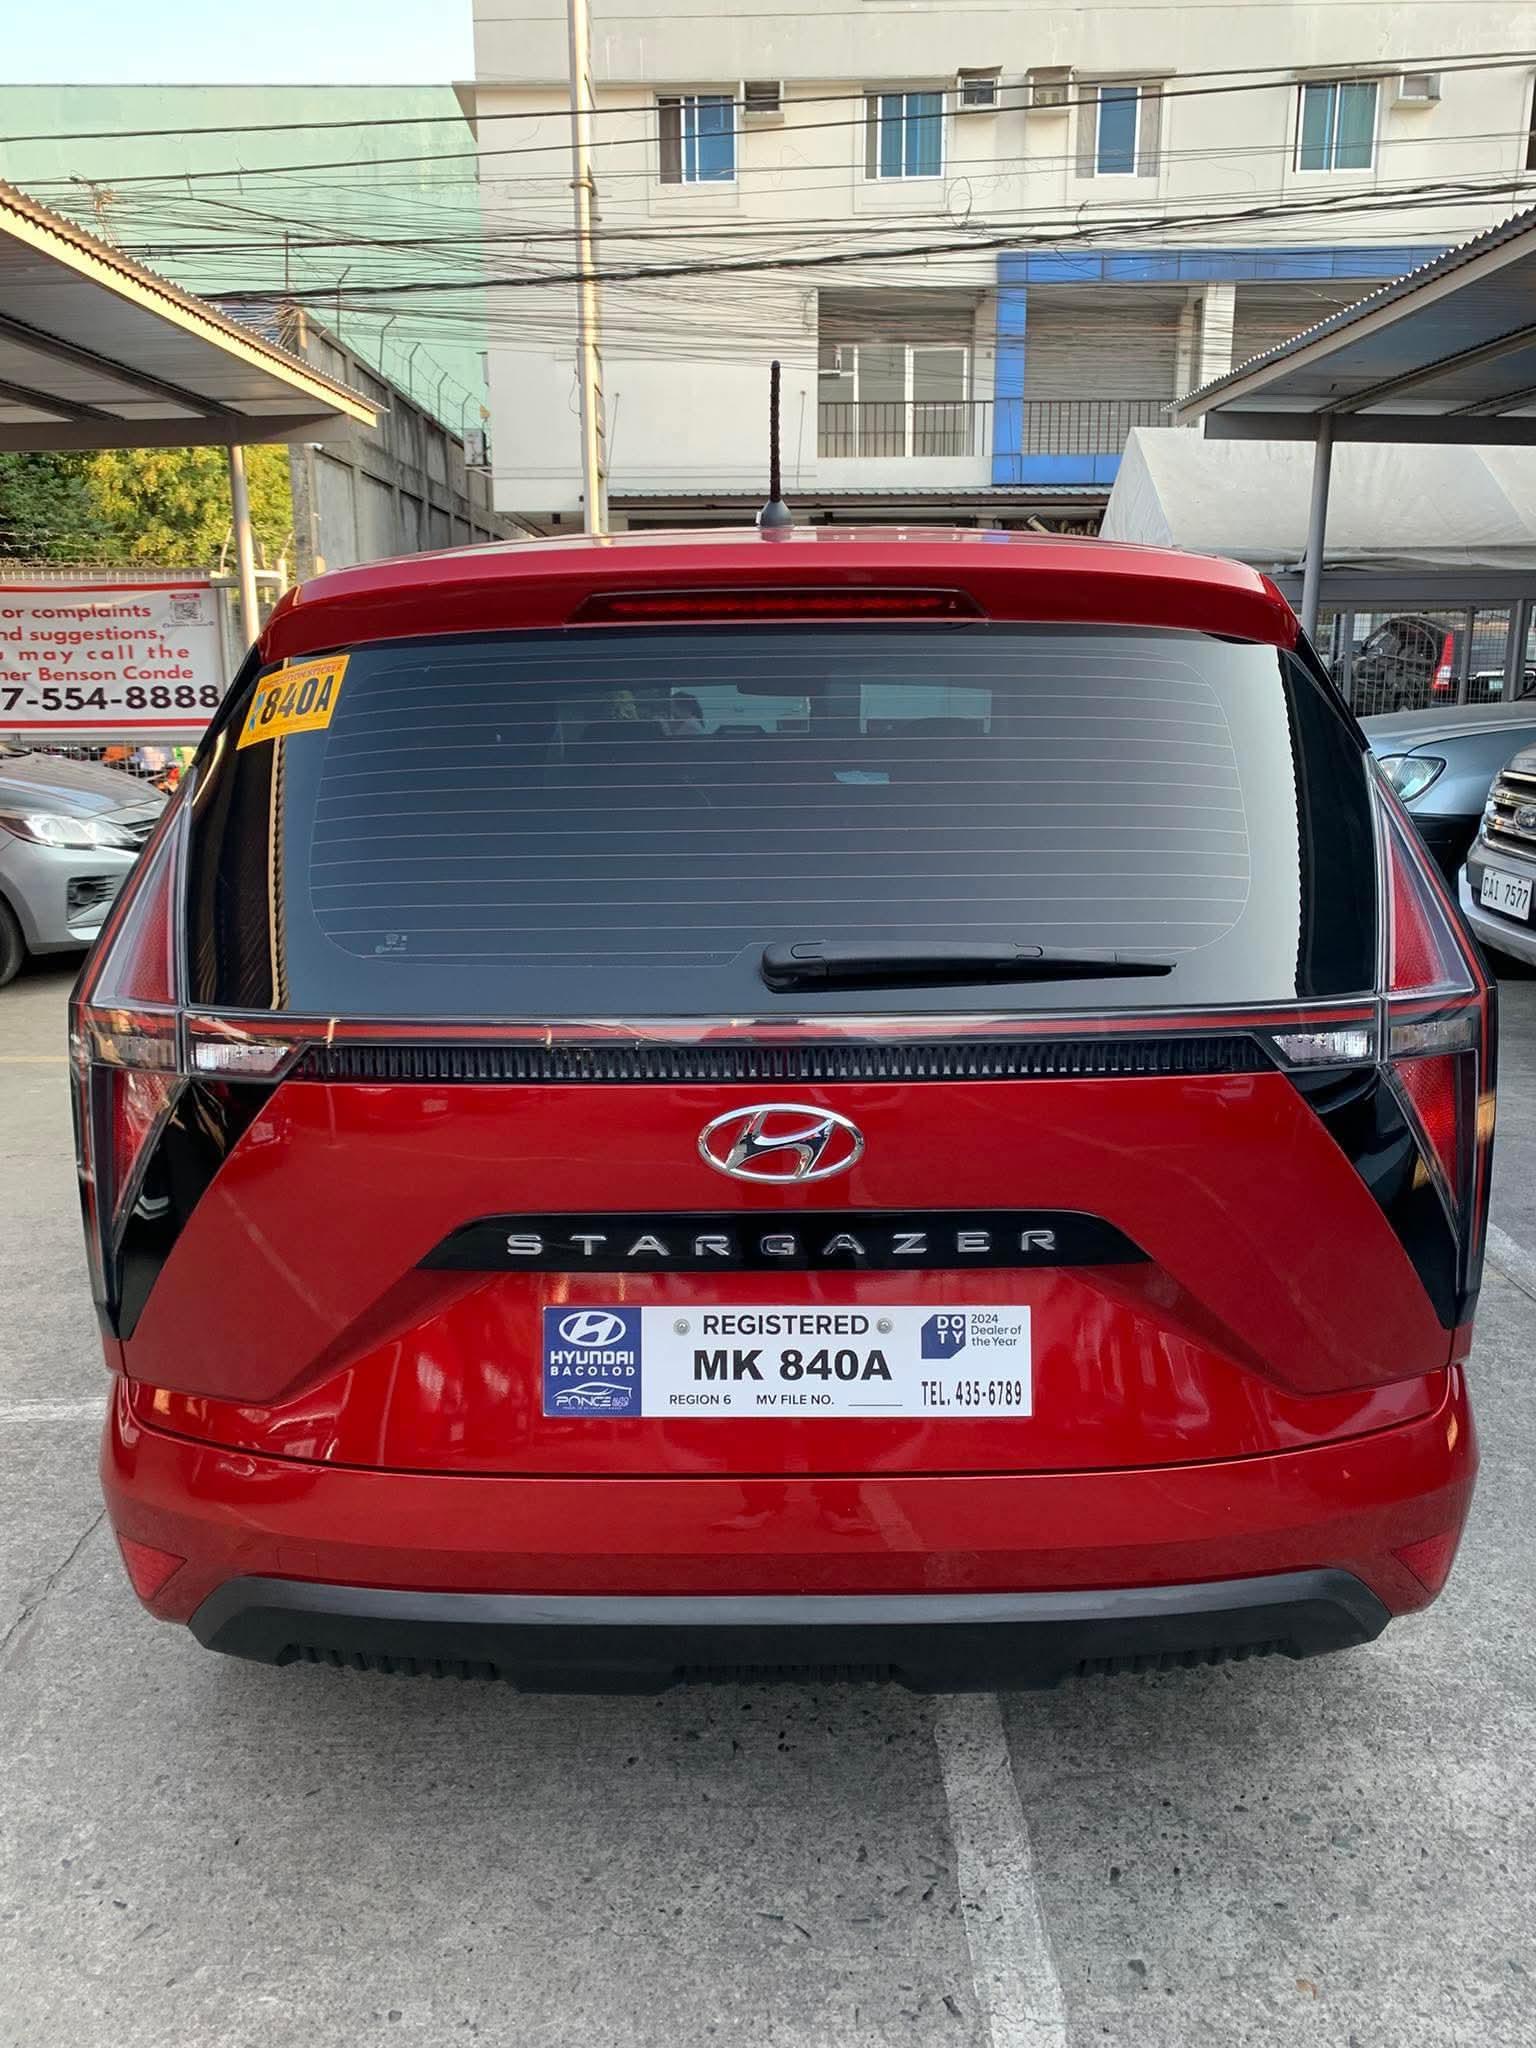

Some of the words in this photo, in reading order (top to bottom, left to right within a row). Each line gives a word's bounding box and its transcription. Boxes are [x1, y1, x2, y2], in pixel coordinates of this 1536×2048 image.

[31, 604, 151, 621] complaints
[30, 626, 165, 645] suggestions,
[19, 651, 73, 664] may
[87, 644, 133, 660] call
[147, 643, 189, 659] the
[38, 667, 116, 681] Benson
[123, 665, 193, 680] Conde
[2, 685, 220, 710] 7-554-8888
[260, 675, 334, 724] 840A
[1505, 884, 1529, 909] 7577
[506, 1229, 1056, 1256] STARGAZER
[703, 1314, 870, 1335] REGISTERED
[971, 1314, 999, 1324] 2024
[971, 1325, 1008, 1335] Dealer
[1009, 1325, 1022, 1335] of
[971, 1337, 991, 1346] the
[992, 1337, 1017, 1346] Year
[550, 1350, 635, 1365] HYUNDAI
[694, 1349, 764, 1381] MK
[779, 1349, 893, 1381] 840A
[550, 1366, 635, 1377] BACOLOD
[669, 1394, 720, 1406] REGION
[723, 1394, 732, 1406] 6
[756, 1394, 778, 1406] MV
[780, 1394, 807, 1406] FILE
[811, 1394, 835, 1406] NO.
[921, 1380, 951, 1406] TEL.
[955, 1380, 1022, 1406] 435-6789
